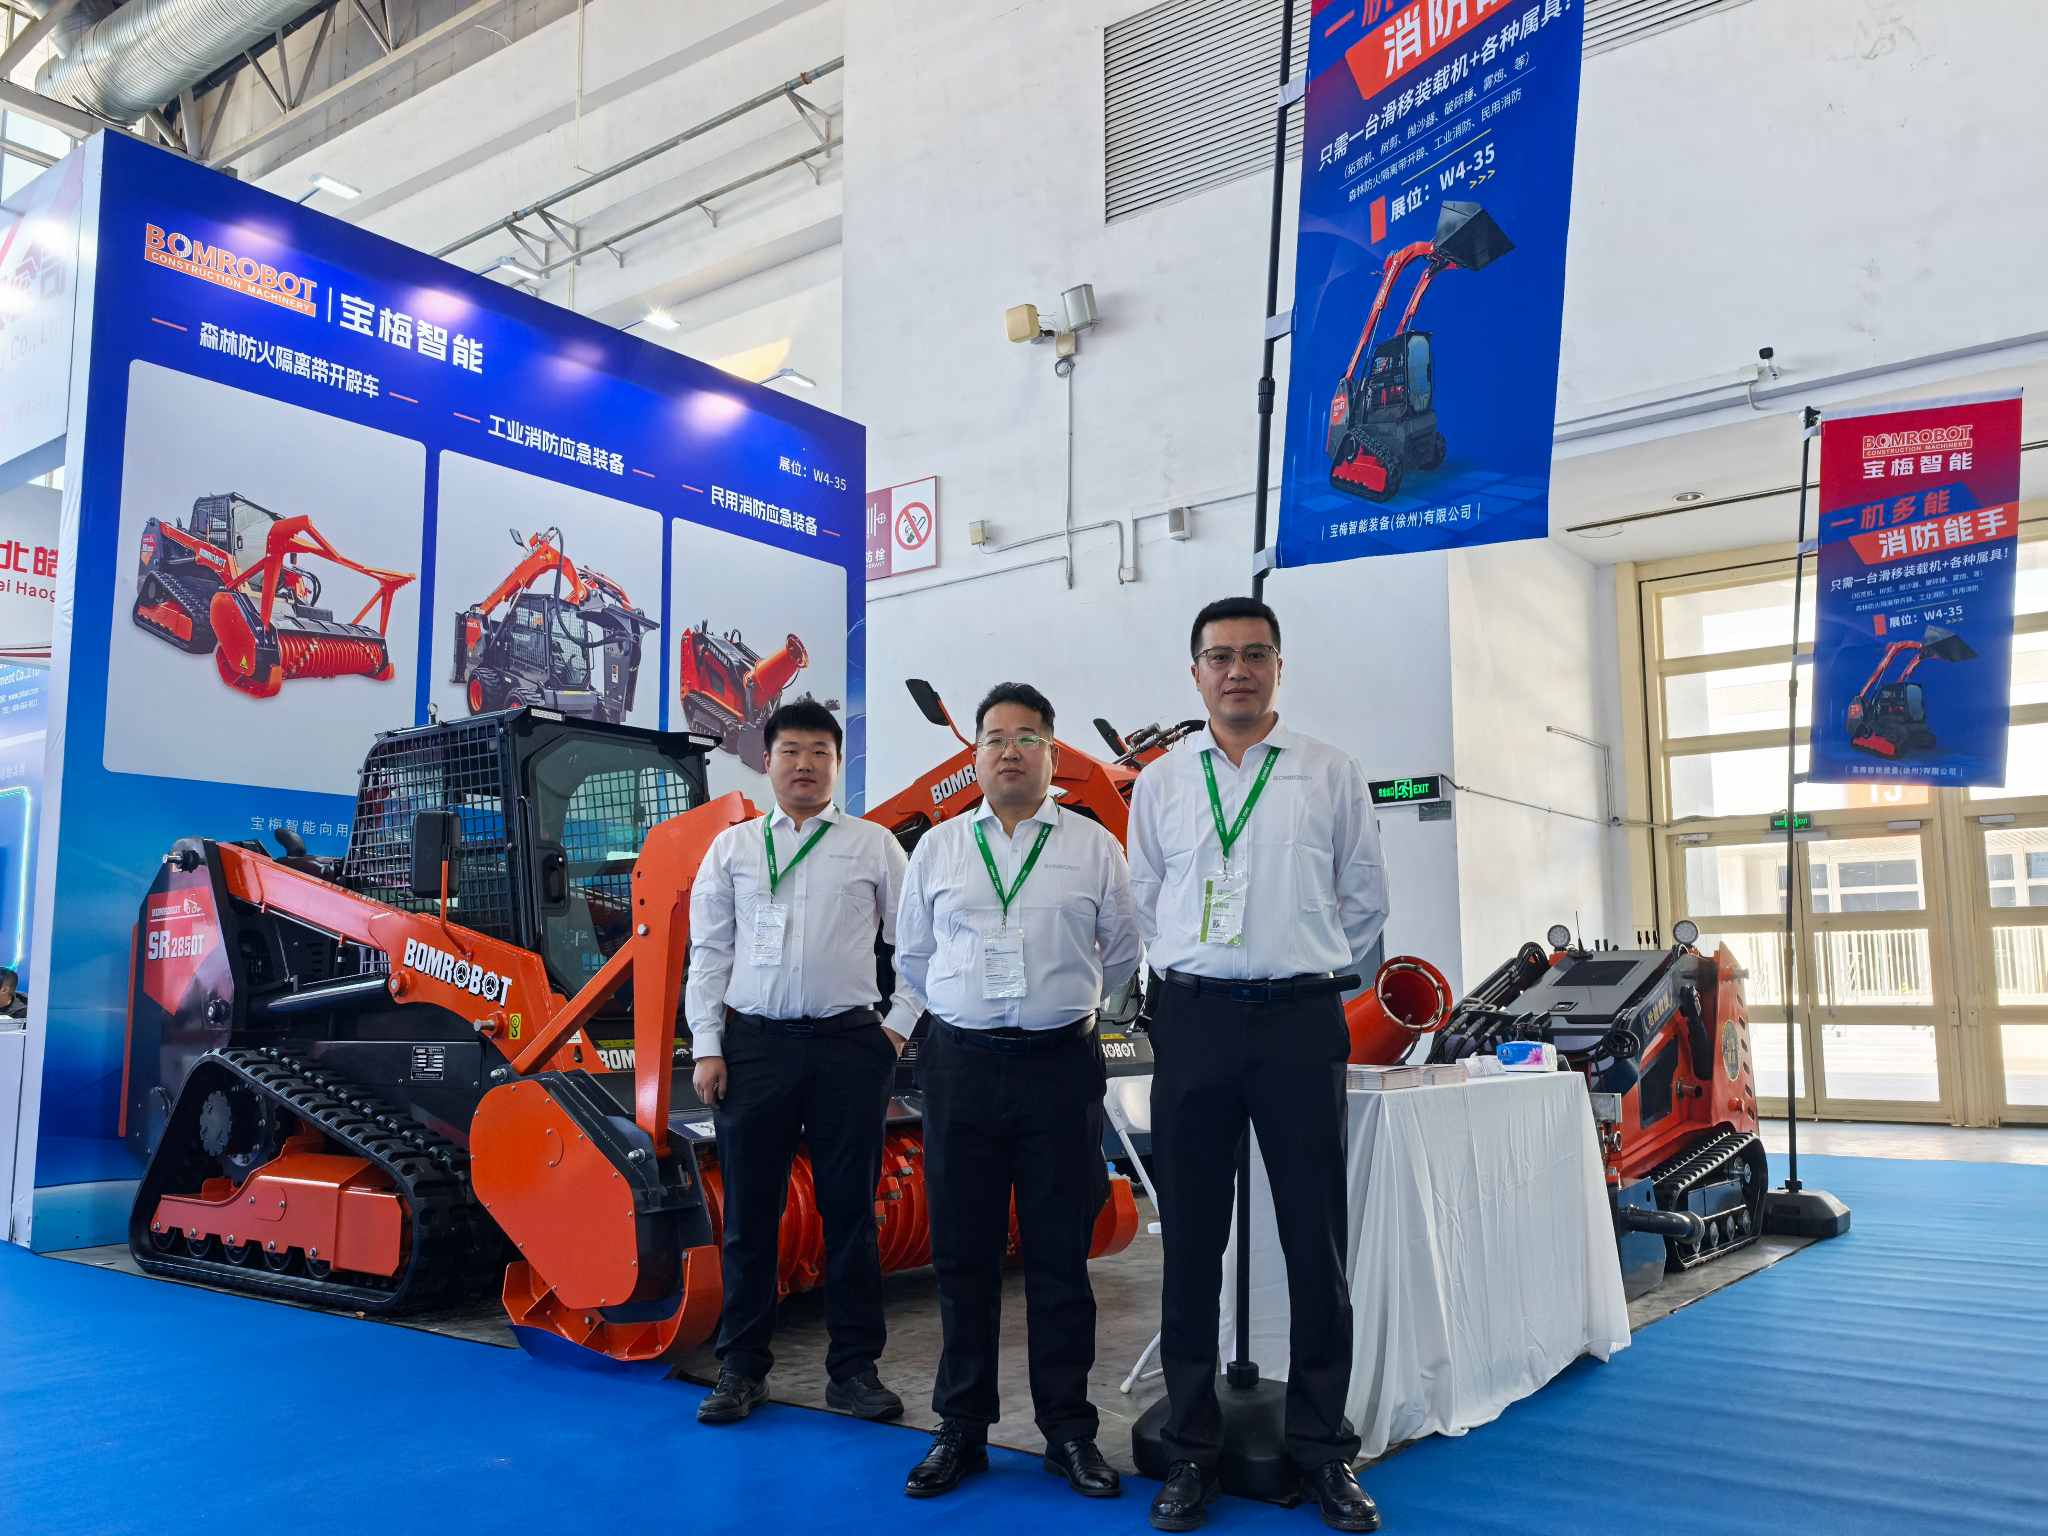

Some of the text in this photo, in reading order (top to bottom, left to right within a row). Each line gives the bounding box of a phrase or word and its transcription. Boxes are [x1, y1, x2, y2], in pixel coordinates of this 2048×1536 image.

[1384, 0, 1502, 78] 消防
[1391, 142, 1496, 223] 展位： W4-35
[145, 222, 318, 303] BOMROBOT
[151, 252, 312, 314] CONSTRUCTION MACHINERY
[200, 321, 380, 399] 森林防火隔离带开辟车
[339, 292, 484, 375] 宝梅智能
[487, 414, 625, 476] 工业消防应急装备
[1863, 425, 1974, 449] BOMROBOT
[779, 455, 847, 491] 展位： W4-35
[1863, 452, 1974, 480] 宝梅智能
[711, 484, 818, 537] 民用消防应急装备
[1831, 489, 1951, 529] 一机多能
[1878, 507, 2008, 559] 消防能手
[1924, 605, 1963, 621] W4-35
[1413, 783, 1430, 795] EXIT
[403, 937, 513, 1007] BOMROBOT
